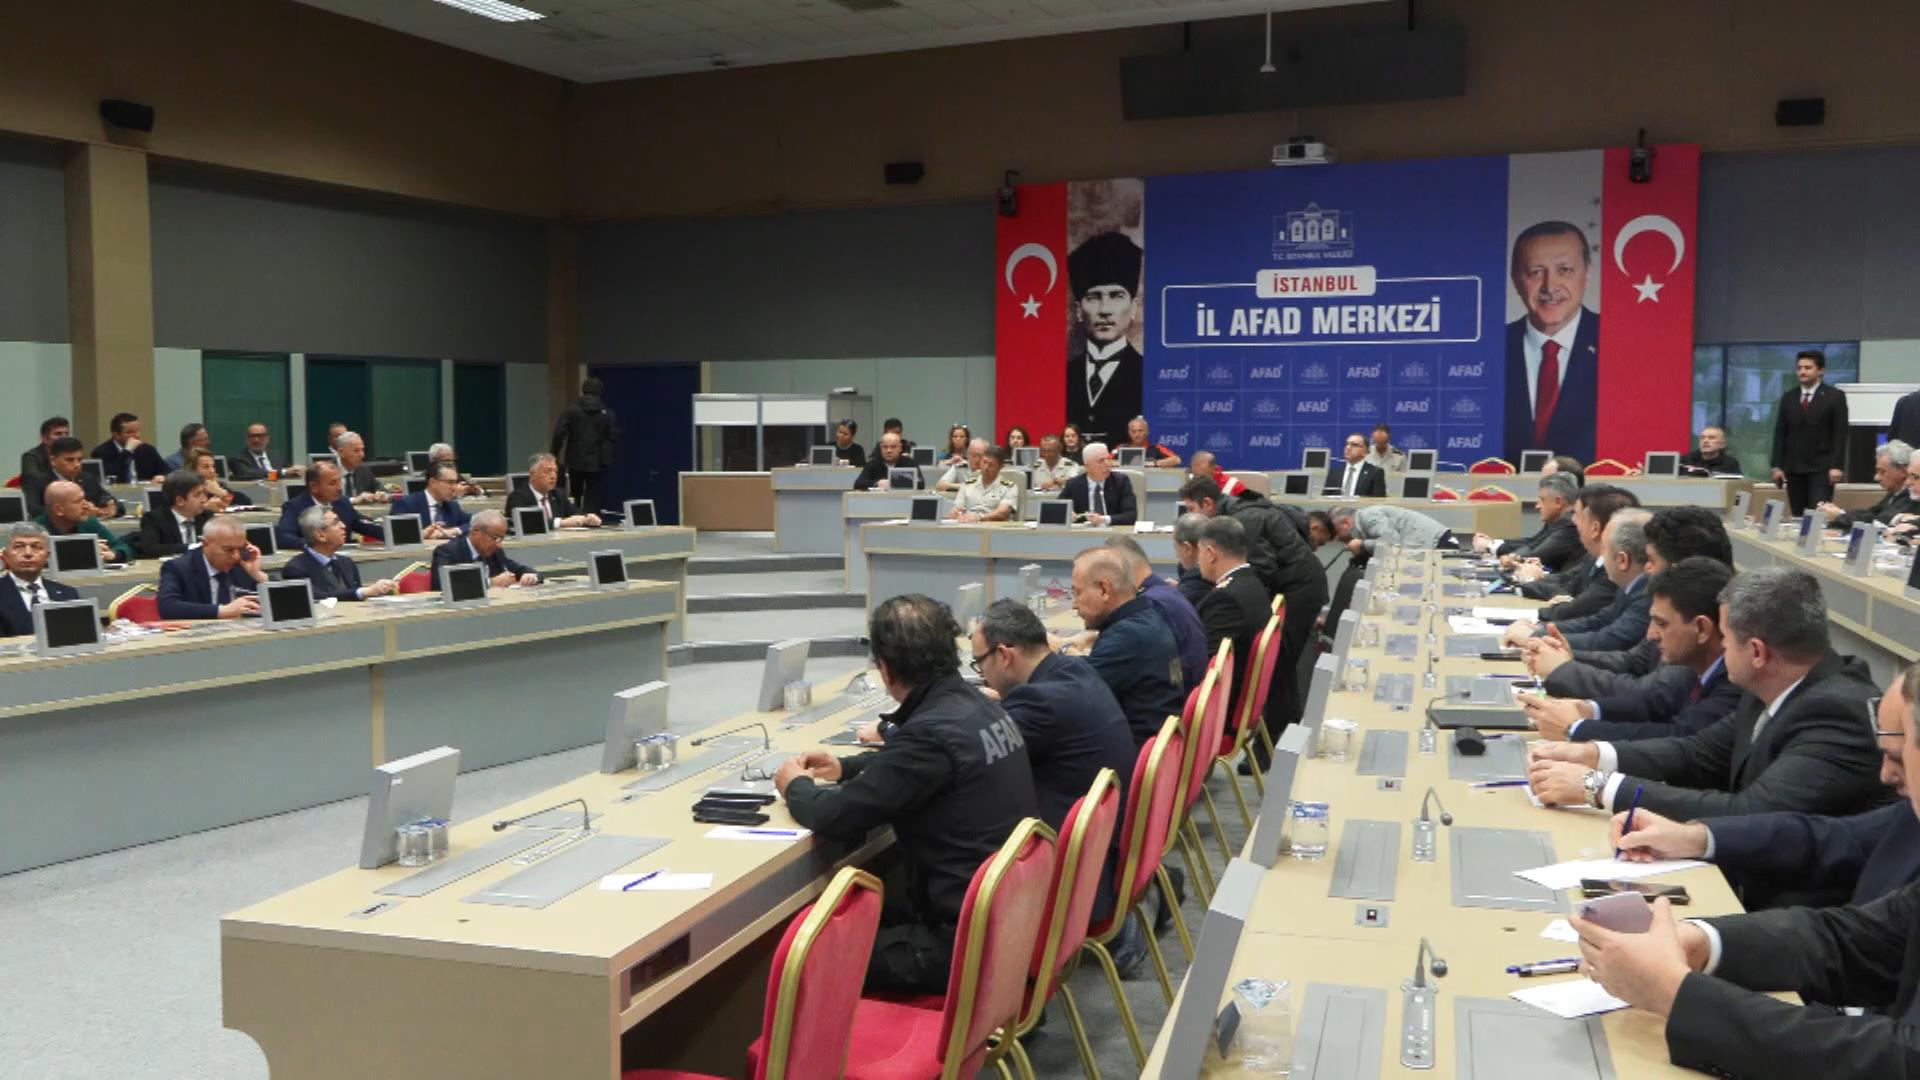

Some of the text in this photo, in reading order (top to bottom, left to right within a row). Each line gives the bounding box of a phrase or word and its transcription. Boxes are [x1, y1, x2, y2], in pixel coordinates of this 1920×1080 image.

[1273, 272, 1358, 293] İSTANBUL
[1197, 297, 1440, 336] İL AFAD MERKEZİ
[1158, 367, 1189, 380] AFAD
[1250, 366, 1281, 379] AFAD
[1347, 365, 1381, 379] AFAD
[1448, 364, 1483, 377] AFAD
[1203, 400, 1233, 413] AFAD
[1297, 399, 1329, 413] AFAD
[1395, 400, 1429, 413] AFAD
[1249, 434, 1281, 447] AFAD
[1447, 435, 1482, 449] AFAD
